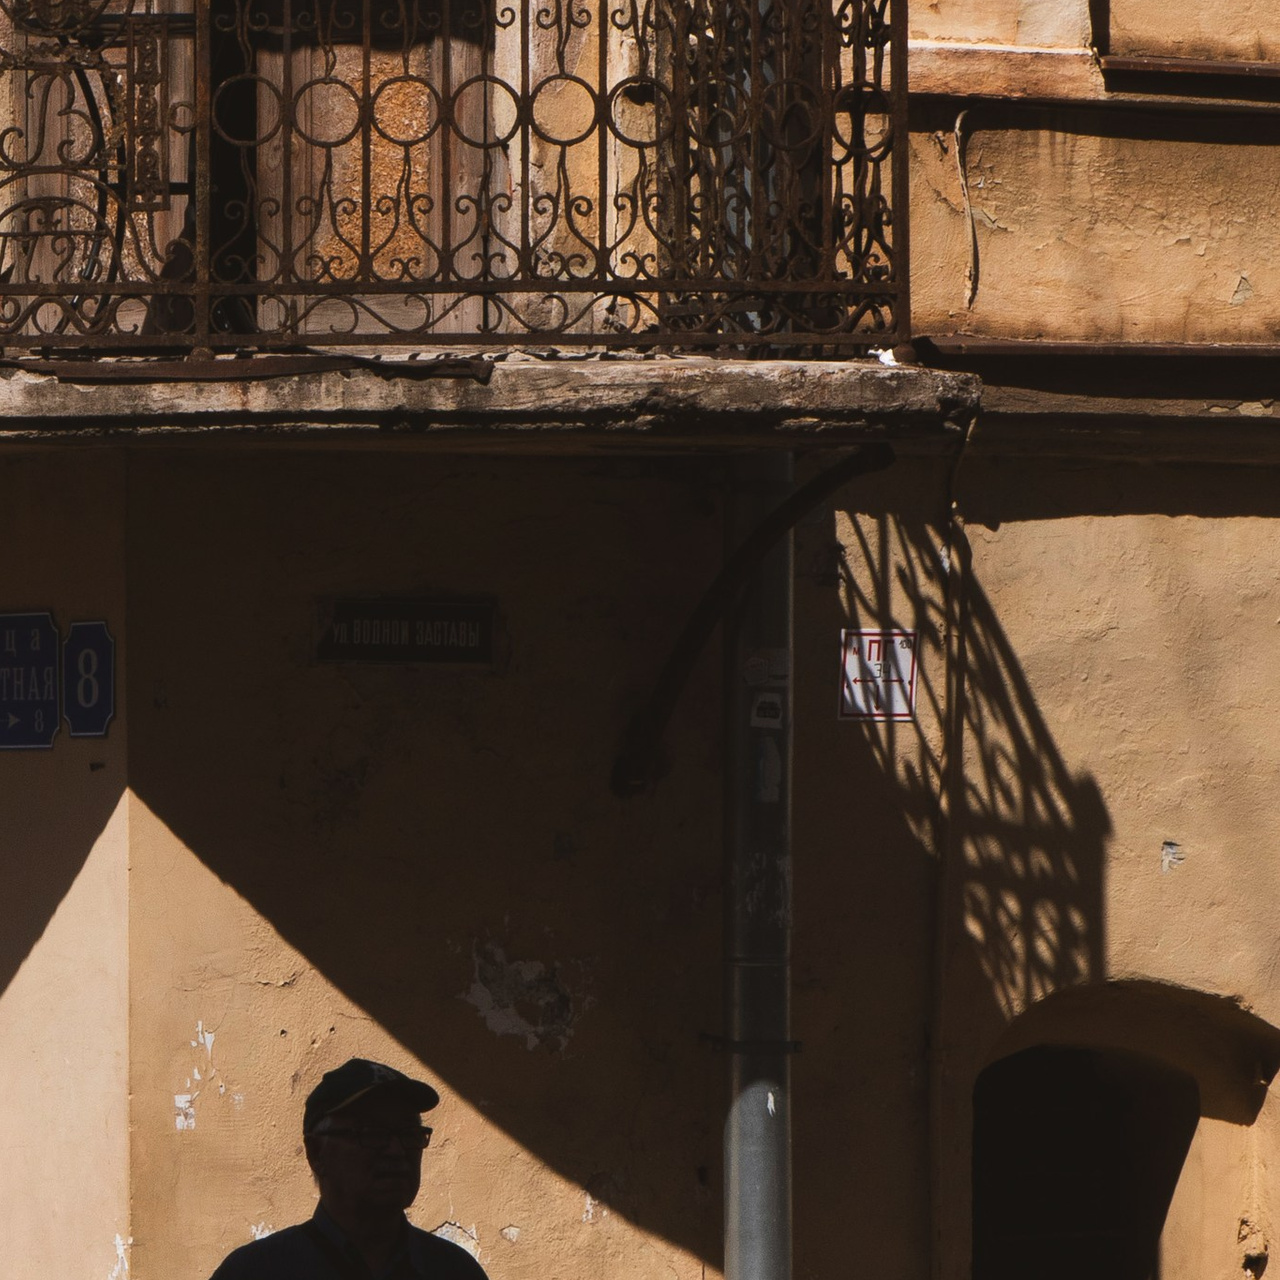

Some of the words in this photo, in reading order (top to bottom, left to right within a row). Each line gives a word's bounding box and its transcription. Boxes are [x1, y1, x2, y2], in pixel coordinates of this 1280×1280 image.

[415, 620, 480, 648] ЗАСТАВЫ
[76, 648, 100, 709] 8
[34, 708, 45, 734] 8
